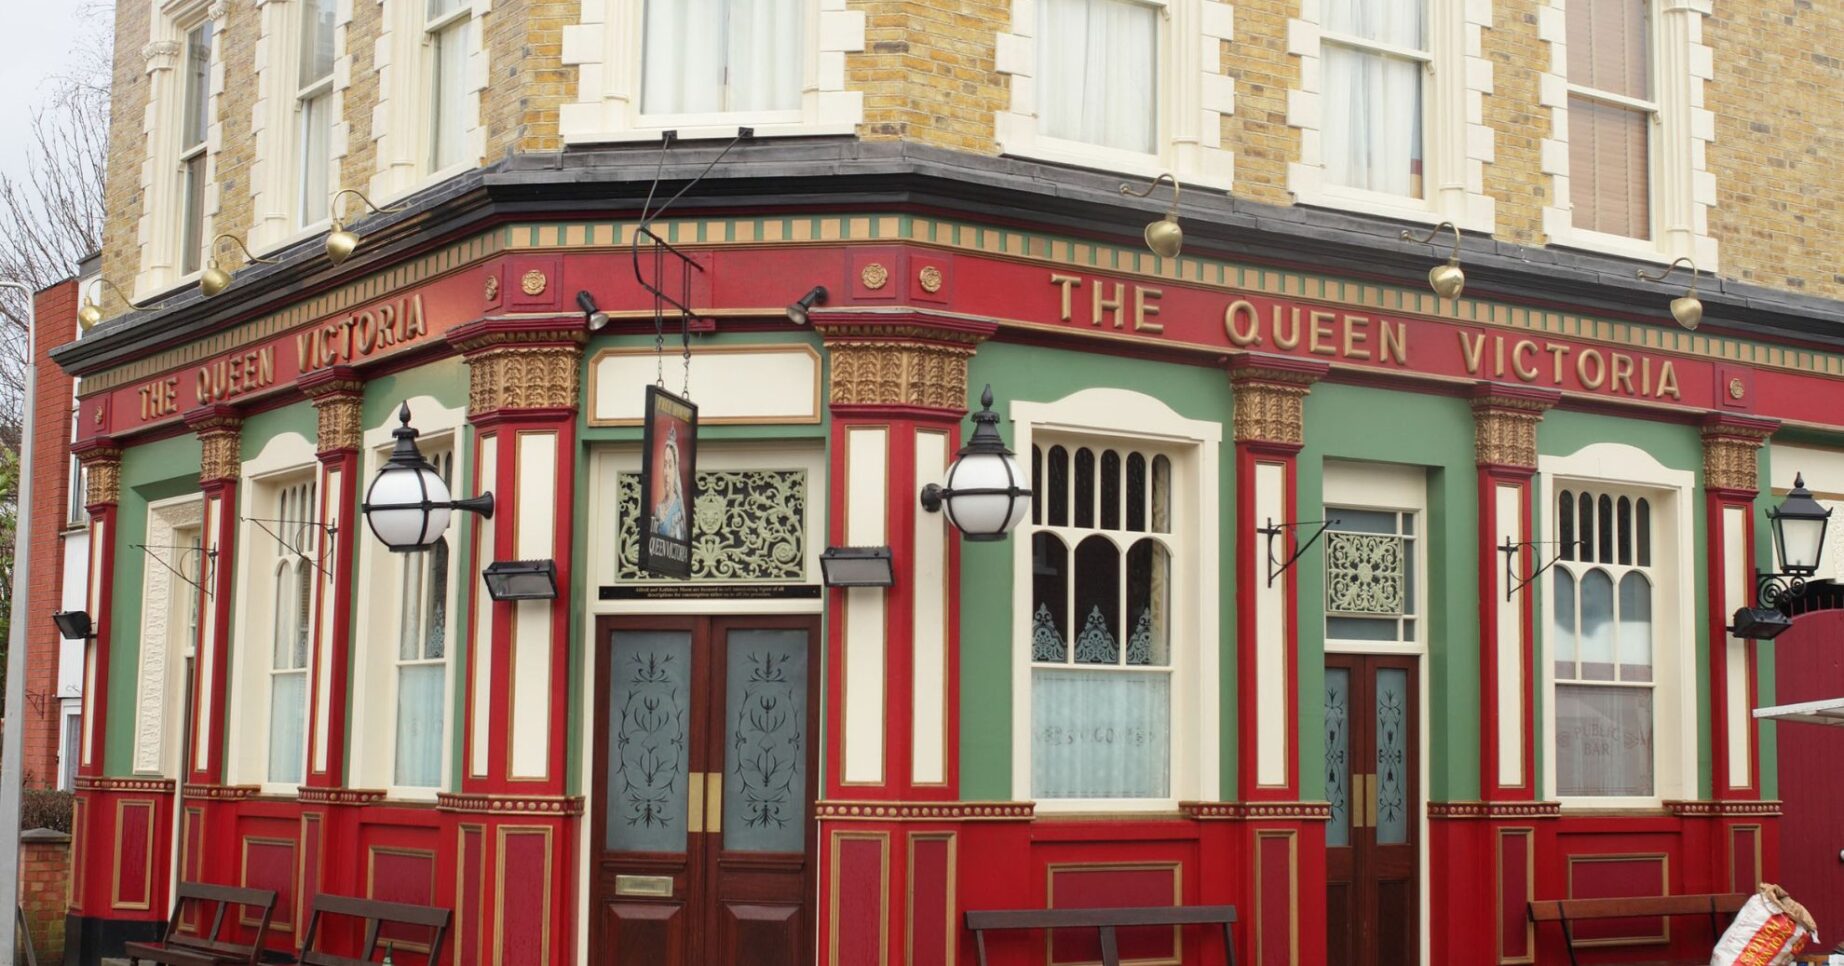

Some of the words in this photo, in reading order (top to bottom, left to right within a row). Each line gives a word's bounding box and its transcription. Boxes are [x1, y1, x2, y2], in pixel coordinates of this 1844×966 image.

[1051, 273, 1164, 333] THE
[1225, 299, 1406, 365] QUEEN
[1458, 330, 1681, 399] VICTORIA
[138, 377, 178, 420] THE
[196, 346, 274, 405] QUEEN
[297, 294, 427, 373] VICTORIA
[648, 536, 666, 557] QUEEN
[666, 541, 688, 563] VICTORIA
[1574, 723, 1618, 742] PUBLIC
[1584, 743, 1610, 756] BAR
